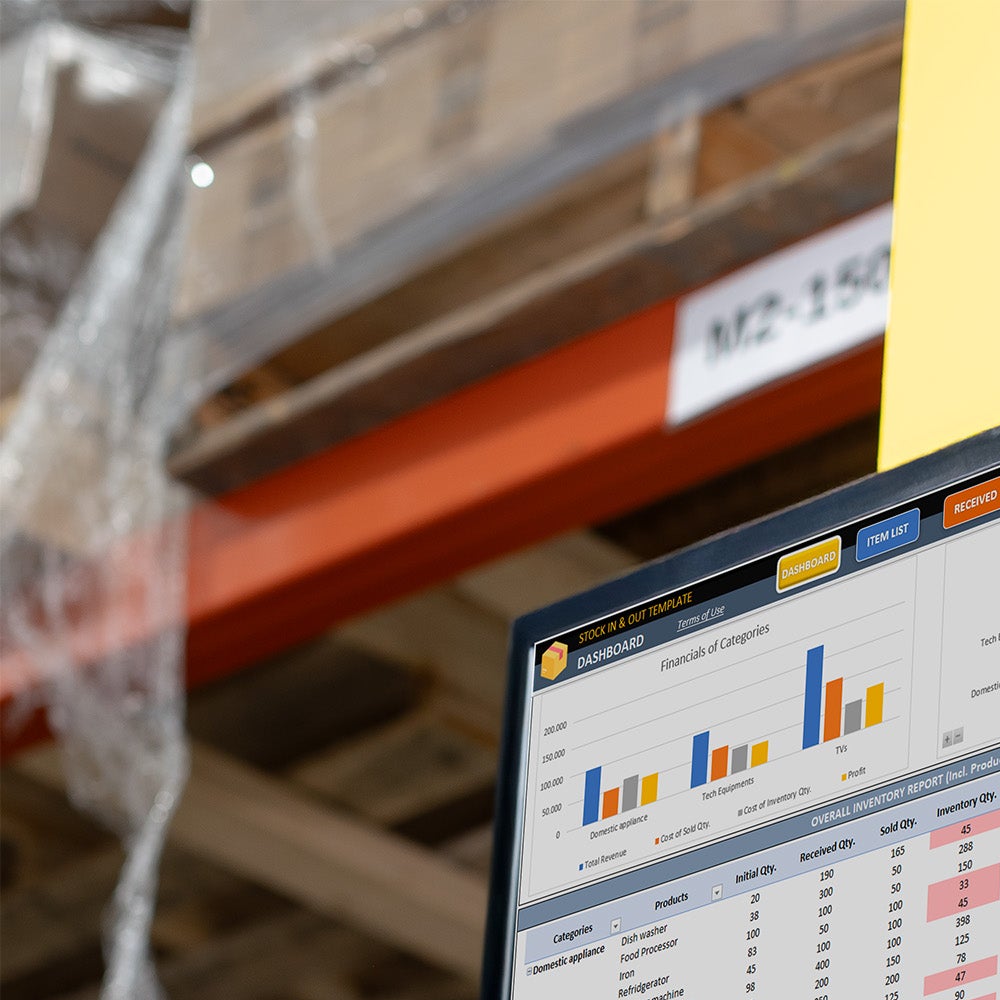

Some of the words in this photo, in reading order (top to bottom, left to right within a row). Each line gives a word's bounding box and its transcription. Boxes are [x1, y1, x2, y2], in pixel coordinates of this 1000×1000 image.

[953, 489, 997, 514] RECEIVED
[866, 529, 889, 547] ITEM
[890, 522, 909, 538] LIST
[781, 550, 836, 579] DASHBOARD
[578, 623, 606, 644] STOCK
[606, 619, 617, 633] IN
[617, 615, 626, 629] &
[627, 608, 647, 625] OUT
[647, 590, 692, 617] TEMPLATE
[677, 614, 700, 629] Terms
[700, 607, 711, 620] of
[709, 604, 725, 617] Use
[576, 633, 644, 669] DASHBOARD
[660, 645, 706, 672] Financials
[707, 638, 719, 654] of
[719, 623, 770, 650] Categories
[979, 634, 997, 647] Tech
[542, 720, 567, 736] 200.000
[541, 747, 566, 764] 150.000
[834, 744, 848, 754] TVs
[847, 765, 866, 779] Profit
[539, 775, 564, 791] 100.000
[701, 789, 717, 801] Tech
[717, 776, 754, 796] Equipments
[743, 803, 757, 815] Cost
[758, 799, 766, 810] of
[766, 790, 797, 807] Inventory
[797, 786, 810, 796] Qty.
[810, 805, 851, 827] OVERALL
[852, 786, 906, 813] INVENTORY
[906, 773, 944, 795] REPORT
[945, 765, 968, 785] (Incl.
[936, 796, 978, 817] Inventory
[978, 791, 997, 803] Qty.
[541, 802, 562, 817] 50.000
[554, 829, 561, 839] 0
[589, 823, 618, 840] Domestic
[618, 813, 648, 830] appliance
[659, 832, 674, 843] Cost
[674, 828, 682, 838] of
[682, 823, 696, 836] Sold
[696, 820, 710, 831] Qty.
[879, 820, 898, 836] Sold
[899, 817, 917, 830] Qty.
[960, 823, 971, 834] 45
[584, 856, 600, 869] Total
[599, 848, 627, 863] Revenue
[799, 840, 837, 863] Received
[837, 837, 855, 850] Qty.
[890, 844, 905, 859] 165
[735, 866, 759, 884] Initial
[759, 863, 777, 876] Qty.
[819, 868, 834, 882] 190
[958, 878, 969, 890] 33
[654, 892, 688, 910] Products
[749, 892, 760, 904] 20
[888, 899, 903, 913] 100
[552, 923, 593, 944] Categories
[620, 932, 638, 946] Dish
[638, 923, 668, 940] washer
[818, 922, 829, 935] 50
[532, 955, 568, 975] Domestic
[567, 944, 605, 964] appliance
[619, 947, 640, 963] Food
[640, 937, 678, 956] Processor
[746, 945, 757, 957] 83
[618, 968, 635, 981] Iron
[617, 974, 670, 998] Refridgerator
